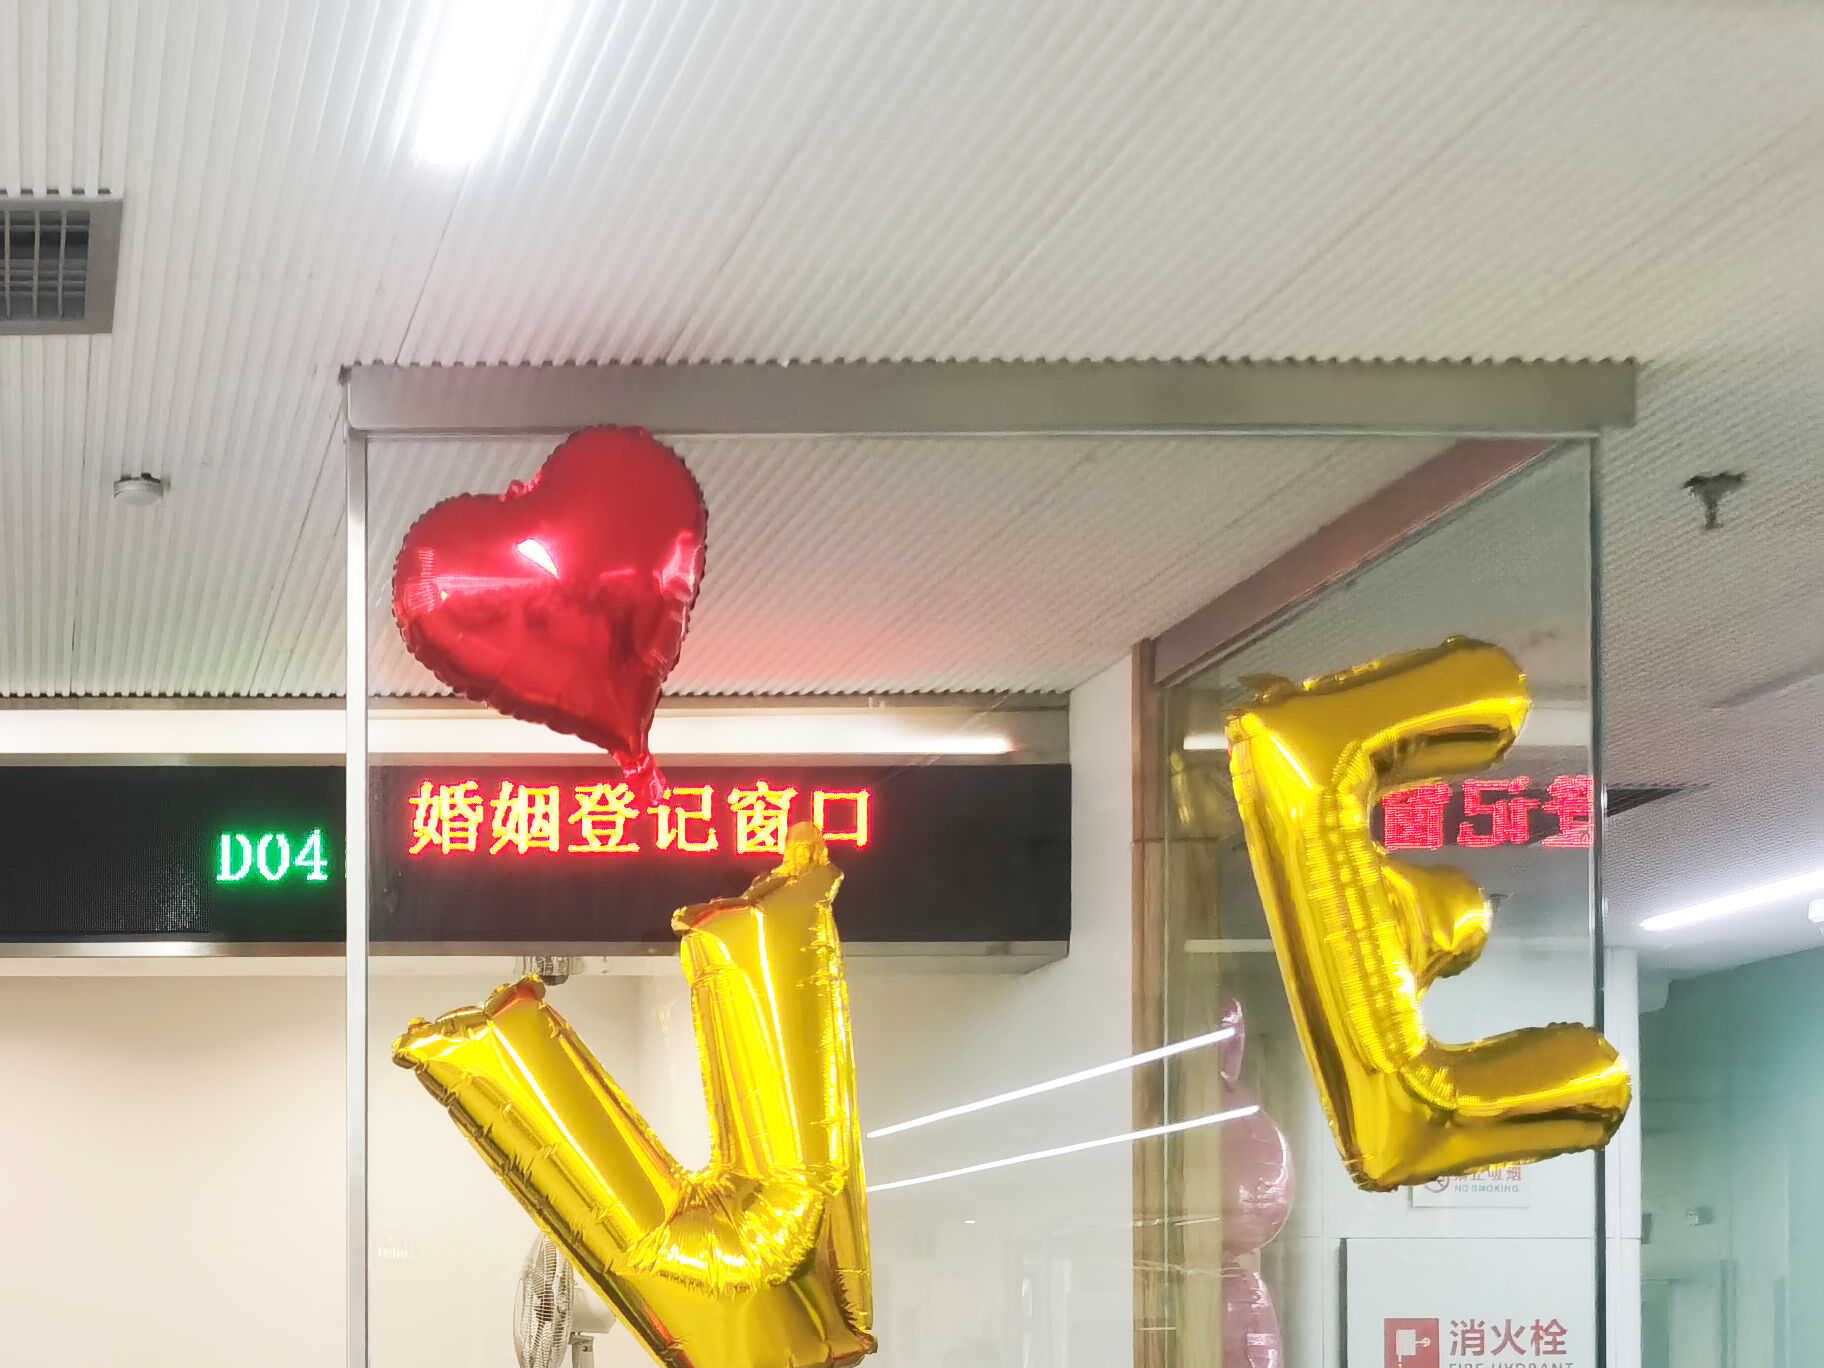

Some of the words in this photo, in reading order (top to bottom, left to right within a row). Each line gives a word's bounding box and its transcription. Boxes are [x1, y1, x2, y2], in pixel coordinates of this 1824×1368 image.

[408, 780, 872, 855] 婚姻登记窗口
[217, 829, 329, 882] D04
[1226, 635, 1631, 1192] E
[1471, 1185, 1519, 1193] SMOKING
[1449, 1318, 1568, 1356] 消火栓
